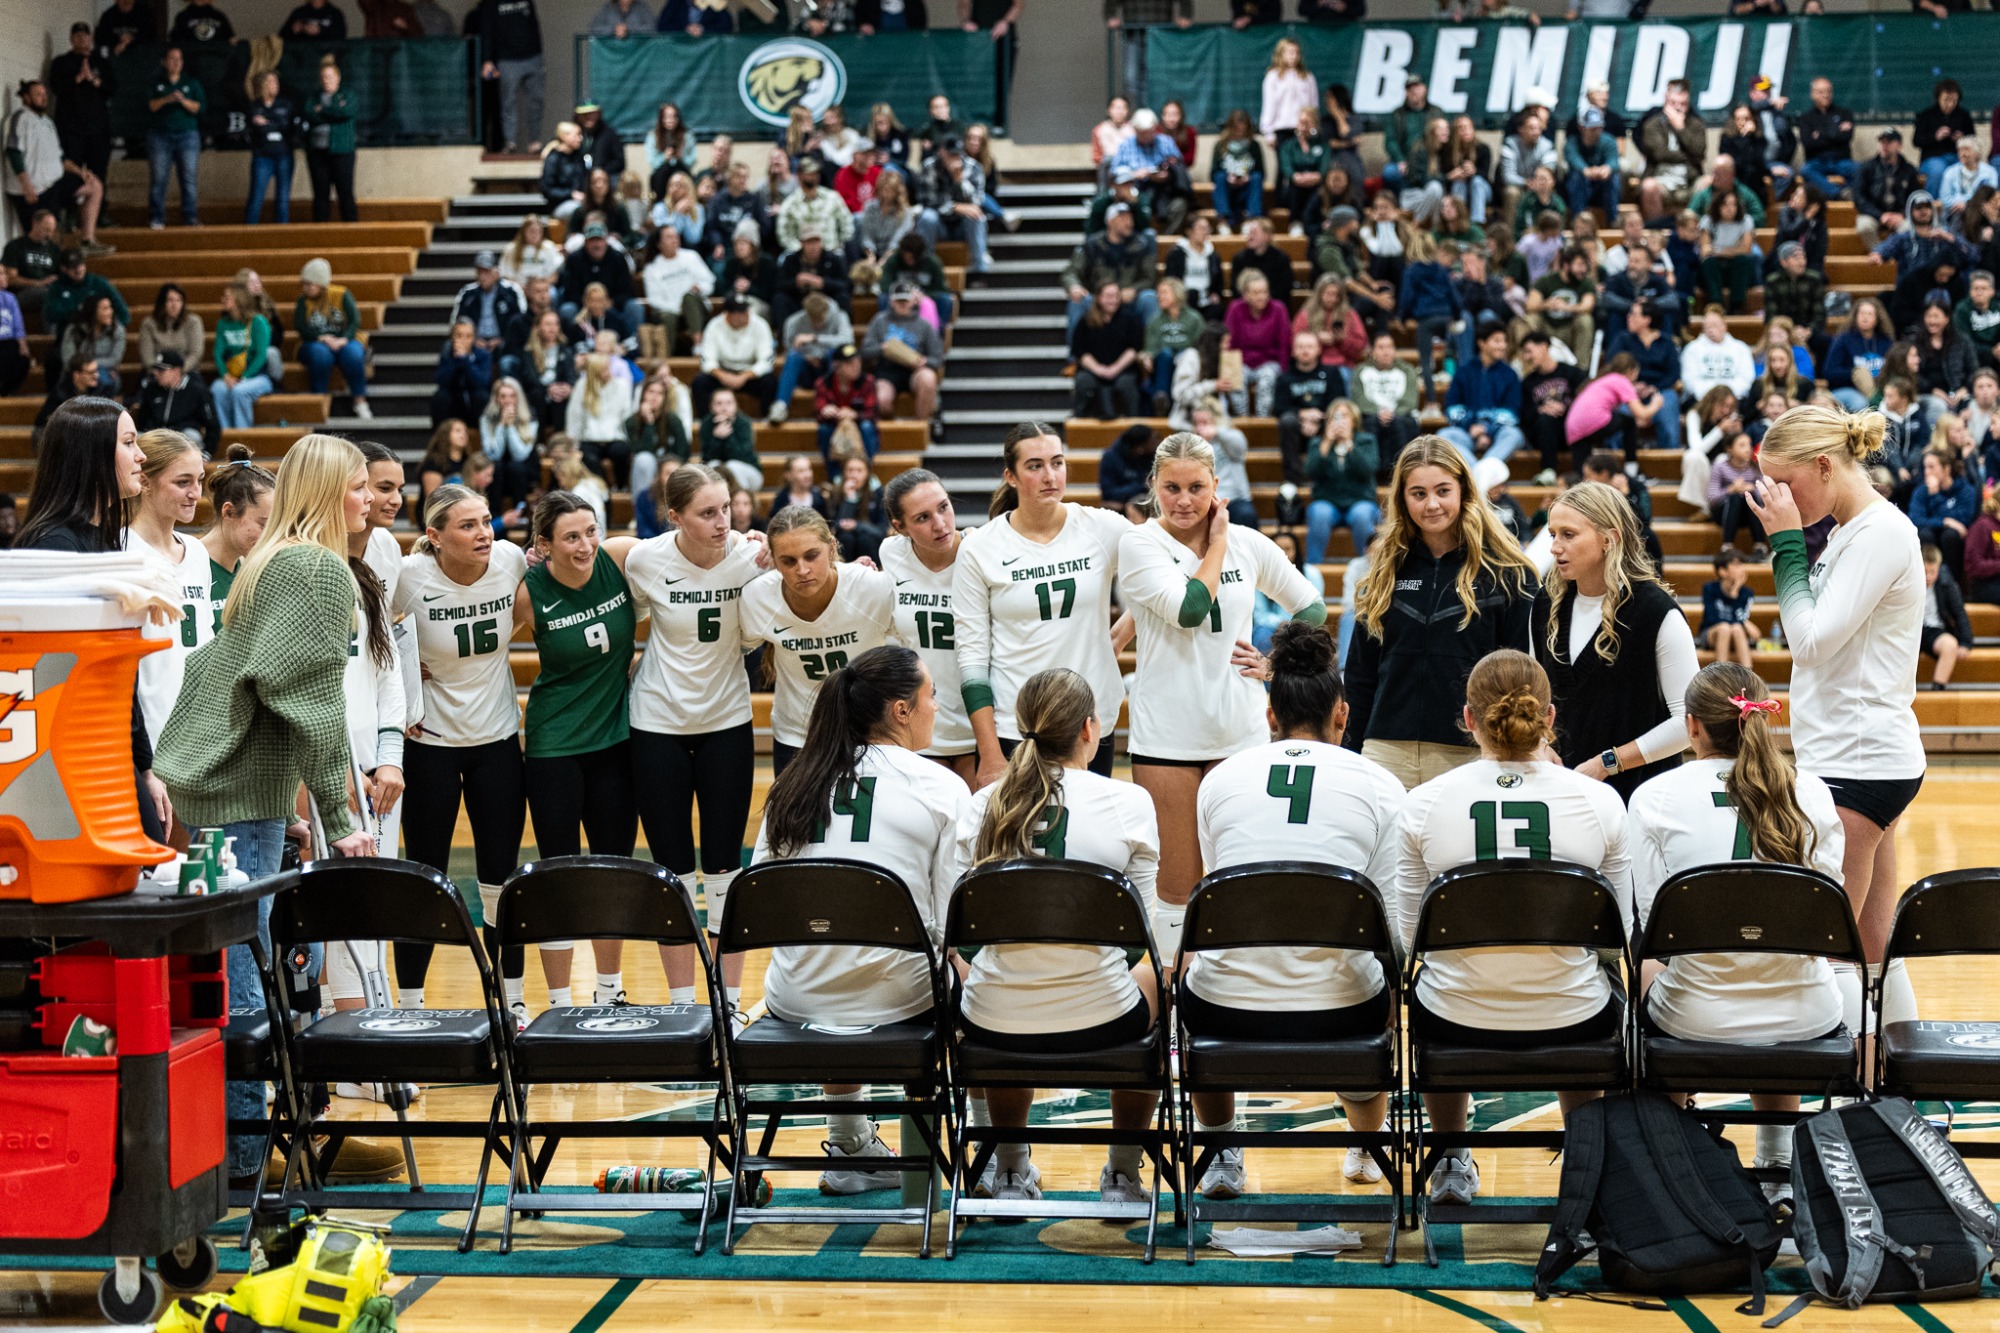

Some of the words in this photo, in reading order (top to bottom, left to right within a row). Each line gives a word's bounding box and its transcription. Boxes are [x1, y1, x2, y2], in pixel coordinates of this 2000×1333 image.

[1352, 22, 1793, 114] BEMIDJI
[1011, 564, 1055, 582] BEMIDJI
[1059, 557, 1091, 575] STATE
[1219, 569, 1243, 585] TATE
[187, 586, 204, 600] STATE
[429, 605, 477, 621] BEMIDJI
[480, 594, 513, 616] STATE
[670, 591, 712, 604] BEMIDJI
[899, 592, 939, 607] BEMIDJI
[1035, 578, 1076, 621] 17
[548, 608, 596, 631] BEMIDJI
[597, 591, 627, 616] STATE
[698, 608, 721, 643] 6
[454, 618, 498, 658] 16
[584, 622, 610, 654] 9
[782, 637, 823, 651] BEMIDJI
[826, 631, 858, 647] STATE
[915, 611, 955, 650] 12
[1266, 765, 1315, 824] 4
[1470, 801, 1552, 860] 13
